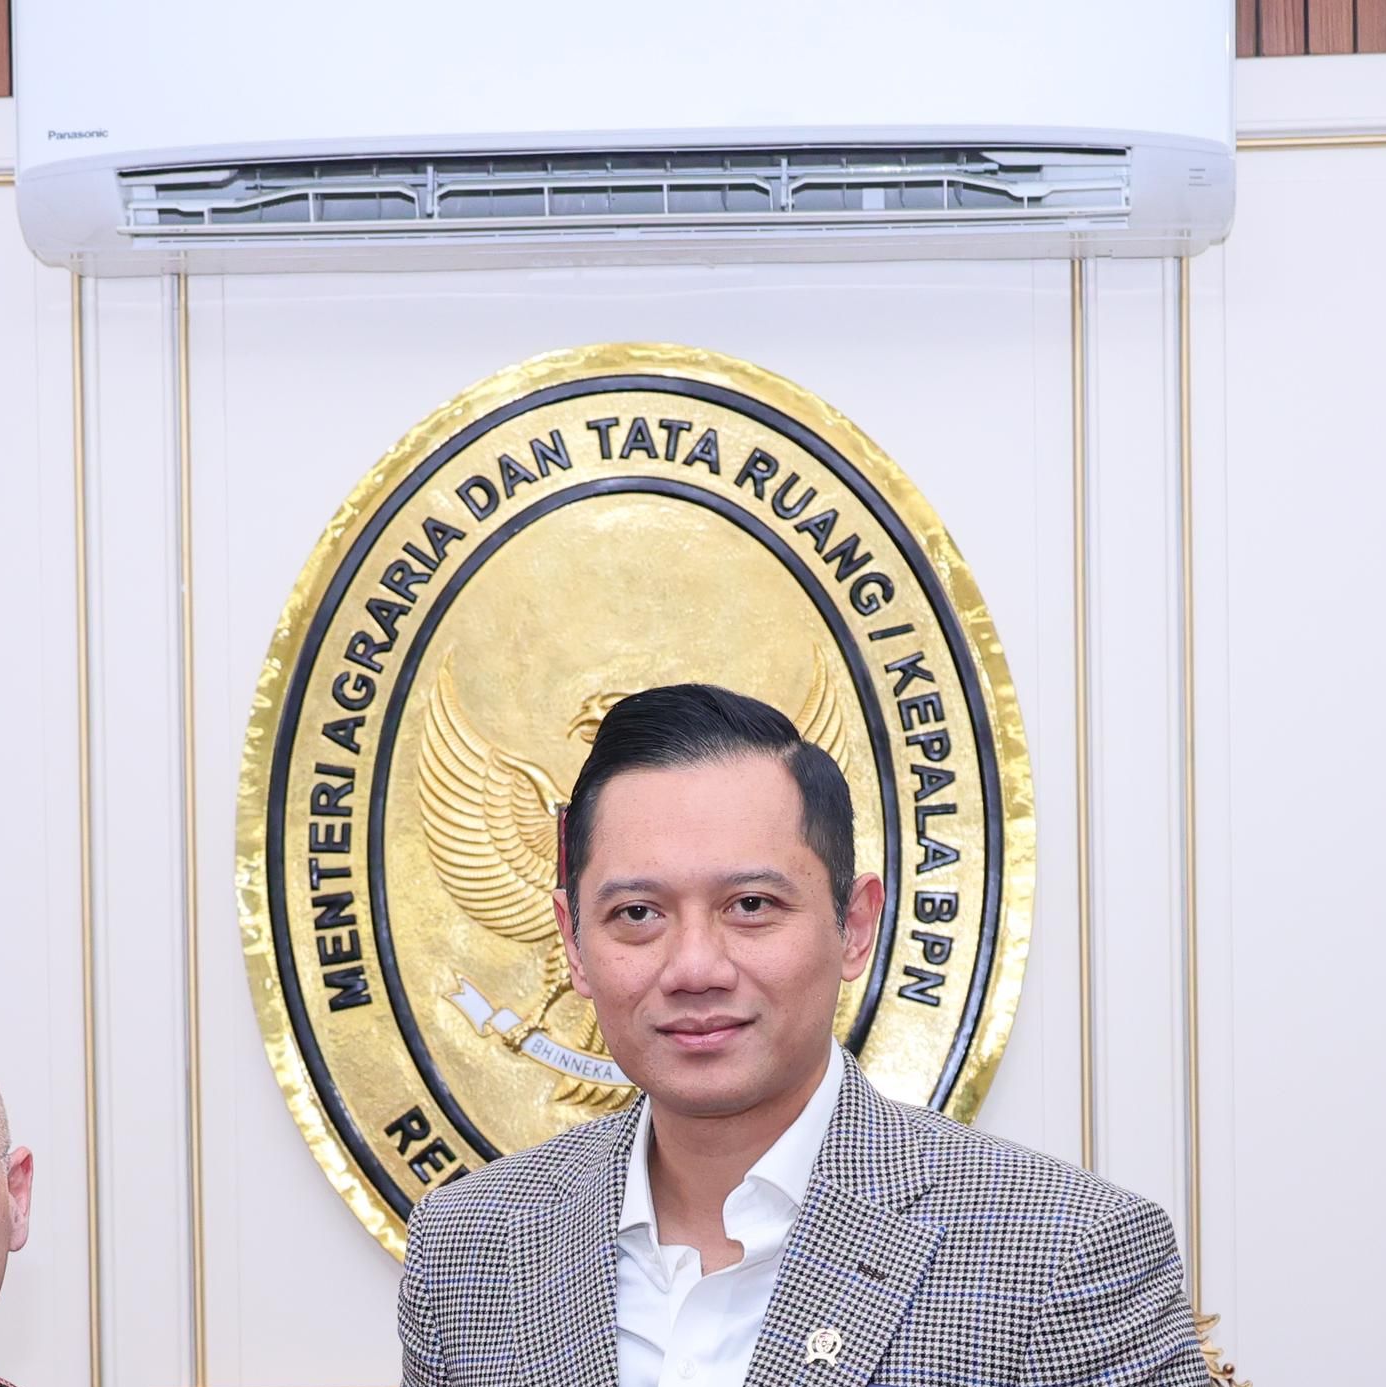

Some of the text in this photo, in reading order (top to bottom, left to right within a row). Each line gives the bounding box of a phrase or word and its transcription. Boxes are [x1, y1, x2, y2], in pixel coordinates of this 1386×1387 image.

[47, 128, 109, 141] Panasonic
[455, 429, 573, 522] DAN
[586, 416, 721, 475] TATA
[733, 447, 896, 617] RUANG
[321, 517, 466, 755] AGRARIA
[884, 650, 960, 875] KEPALA
[308, 762, 373, 1012] MENTERI
[897, 890, 959, 1007] BPN
[531, 1039, 613, 1080] BHINNEKA
